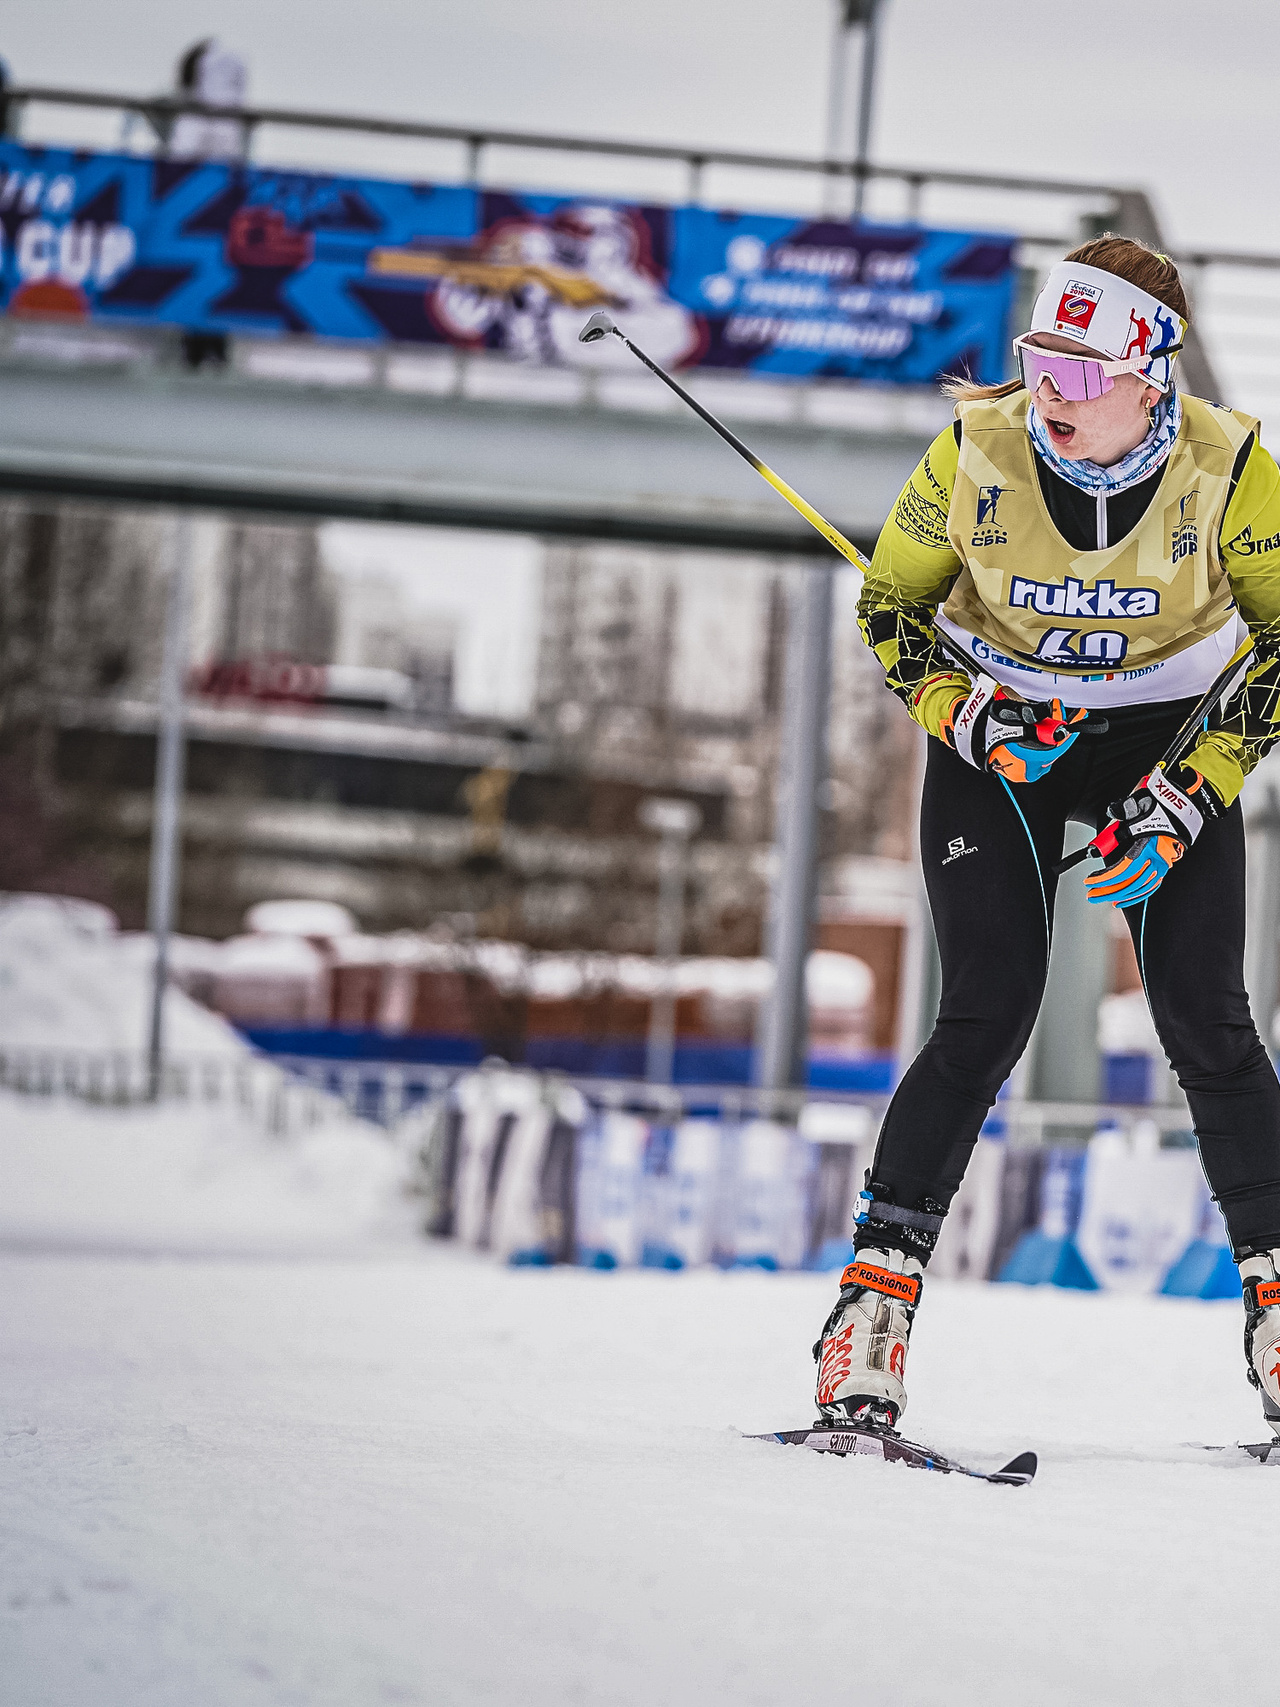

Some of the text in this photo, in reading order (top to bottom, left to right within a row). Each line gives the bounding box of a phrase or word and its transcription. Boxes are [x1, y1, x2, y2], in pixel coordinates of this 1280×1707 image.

[15, 219, 138, 288] CUP
[971, 535, 1008, 547] СБР
[1172, 541, 1198, 564] CUP
[1012, 578, 1158, 617] rukka
[941, 846, 979, 866] salomon
[859, 1269, 914, 1296] ROSSIGNOL
